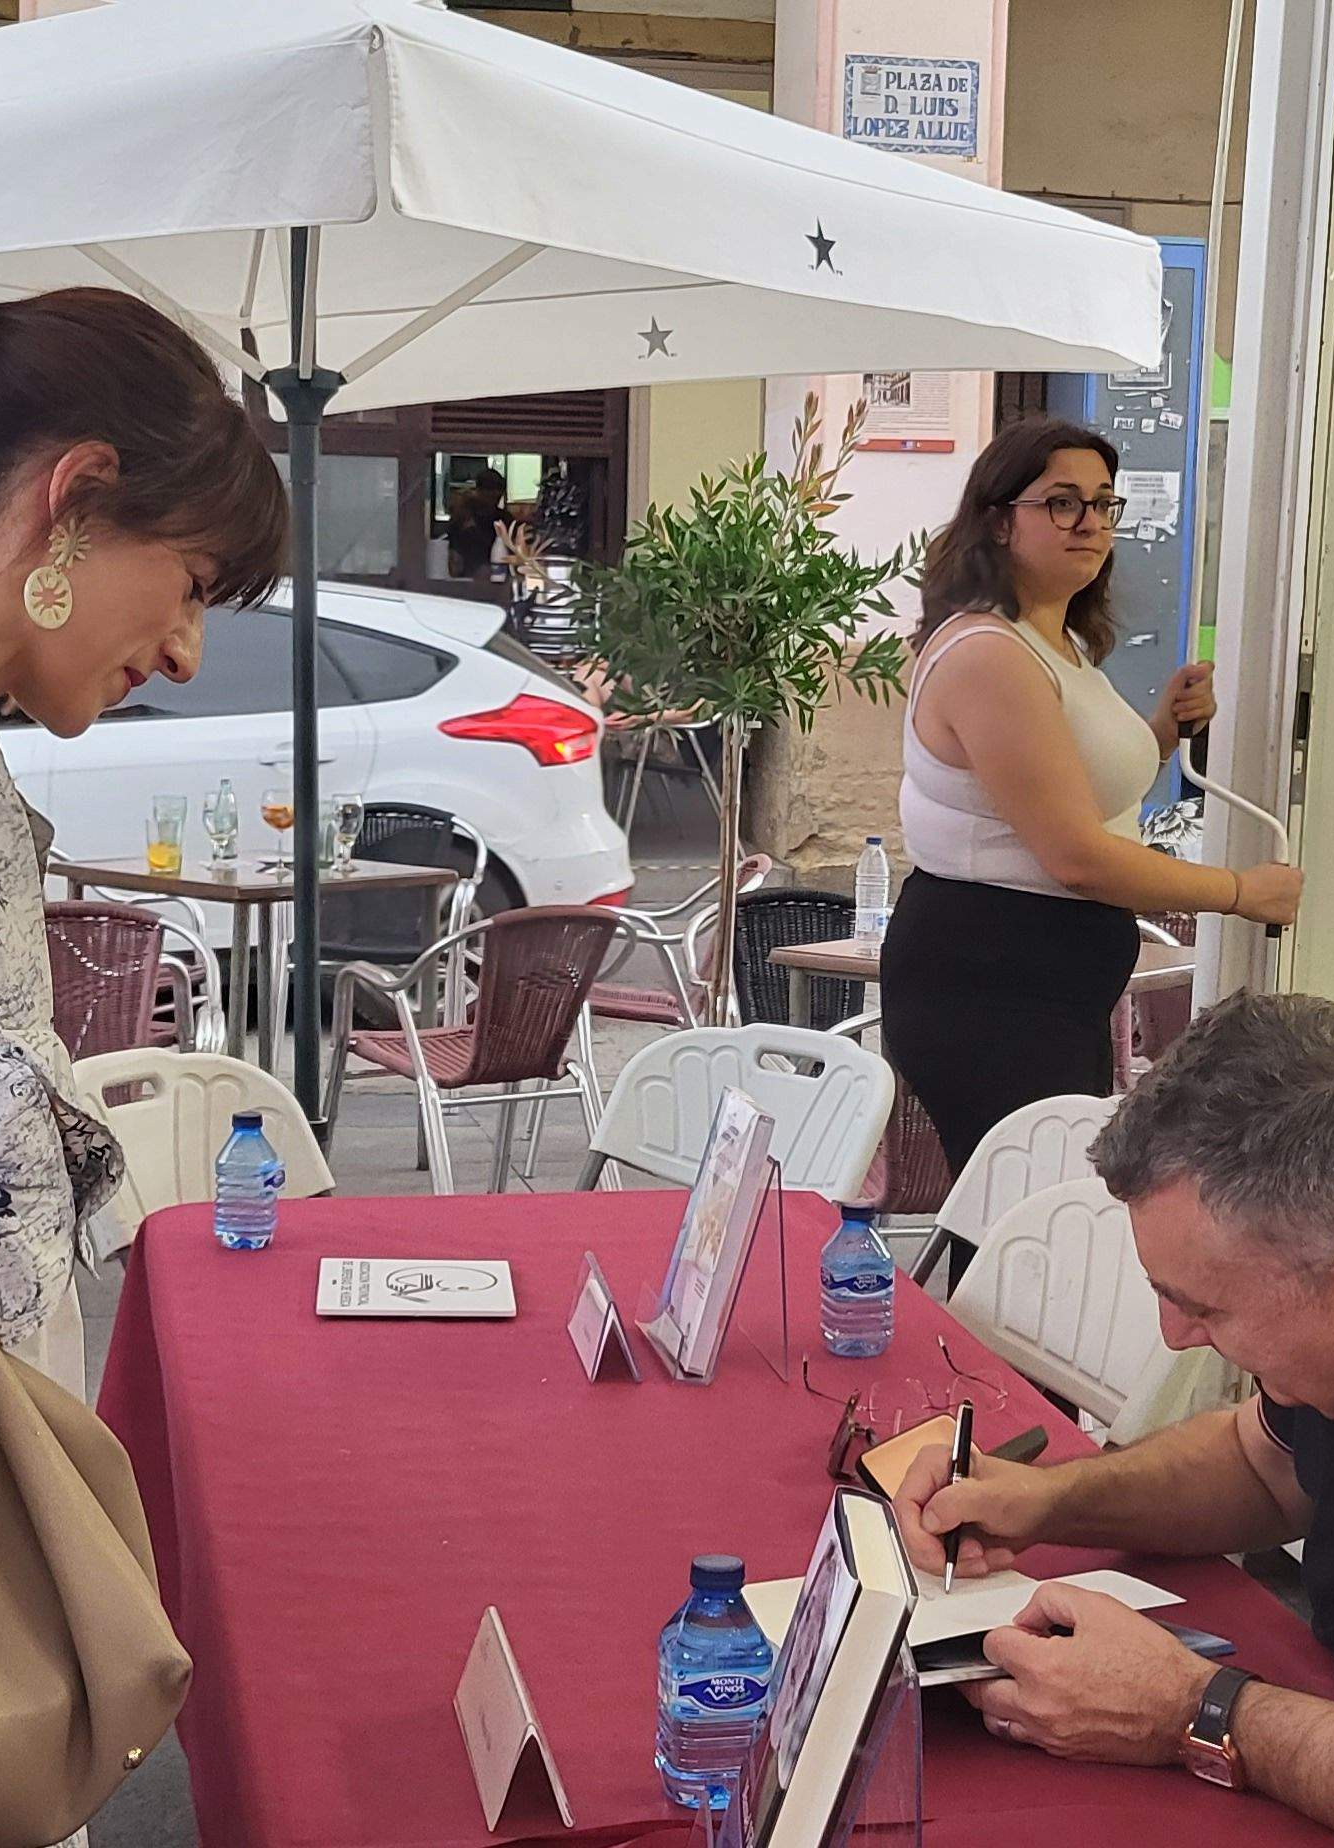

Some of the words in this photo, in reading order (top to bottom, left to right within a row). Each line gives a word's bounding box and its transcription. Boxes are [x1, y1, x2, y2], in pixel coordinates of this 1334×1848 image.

[884, 71, 944, 92] PLAZA
[947, 77, 969, 93] DE
[884, 94, 899, 115] D.
[909, 96, 959, 117] LUIS
[851, 116, 910, 139] LOPEZ
[710, 1677, 745, 1686] MONTE
[714, 1685, 746, 1693] PINOS
